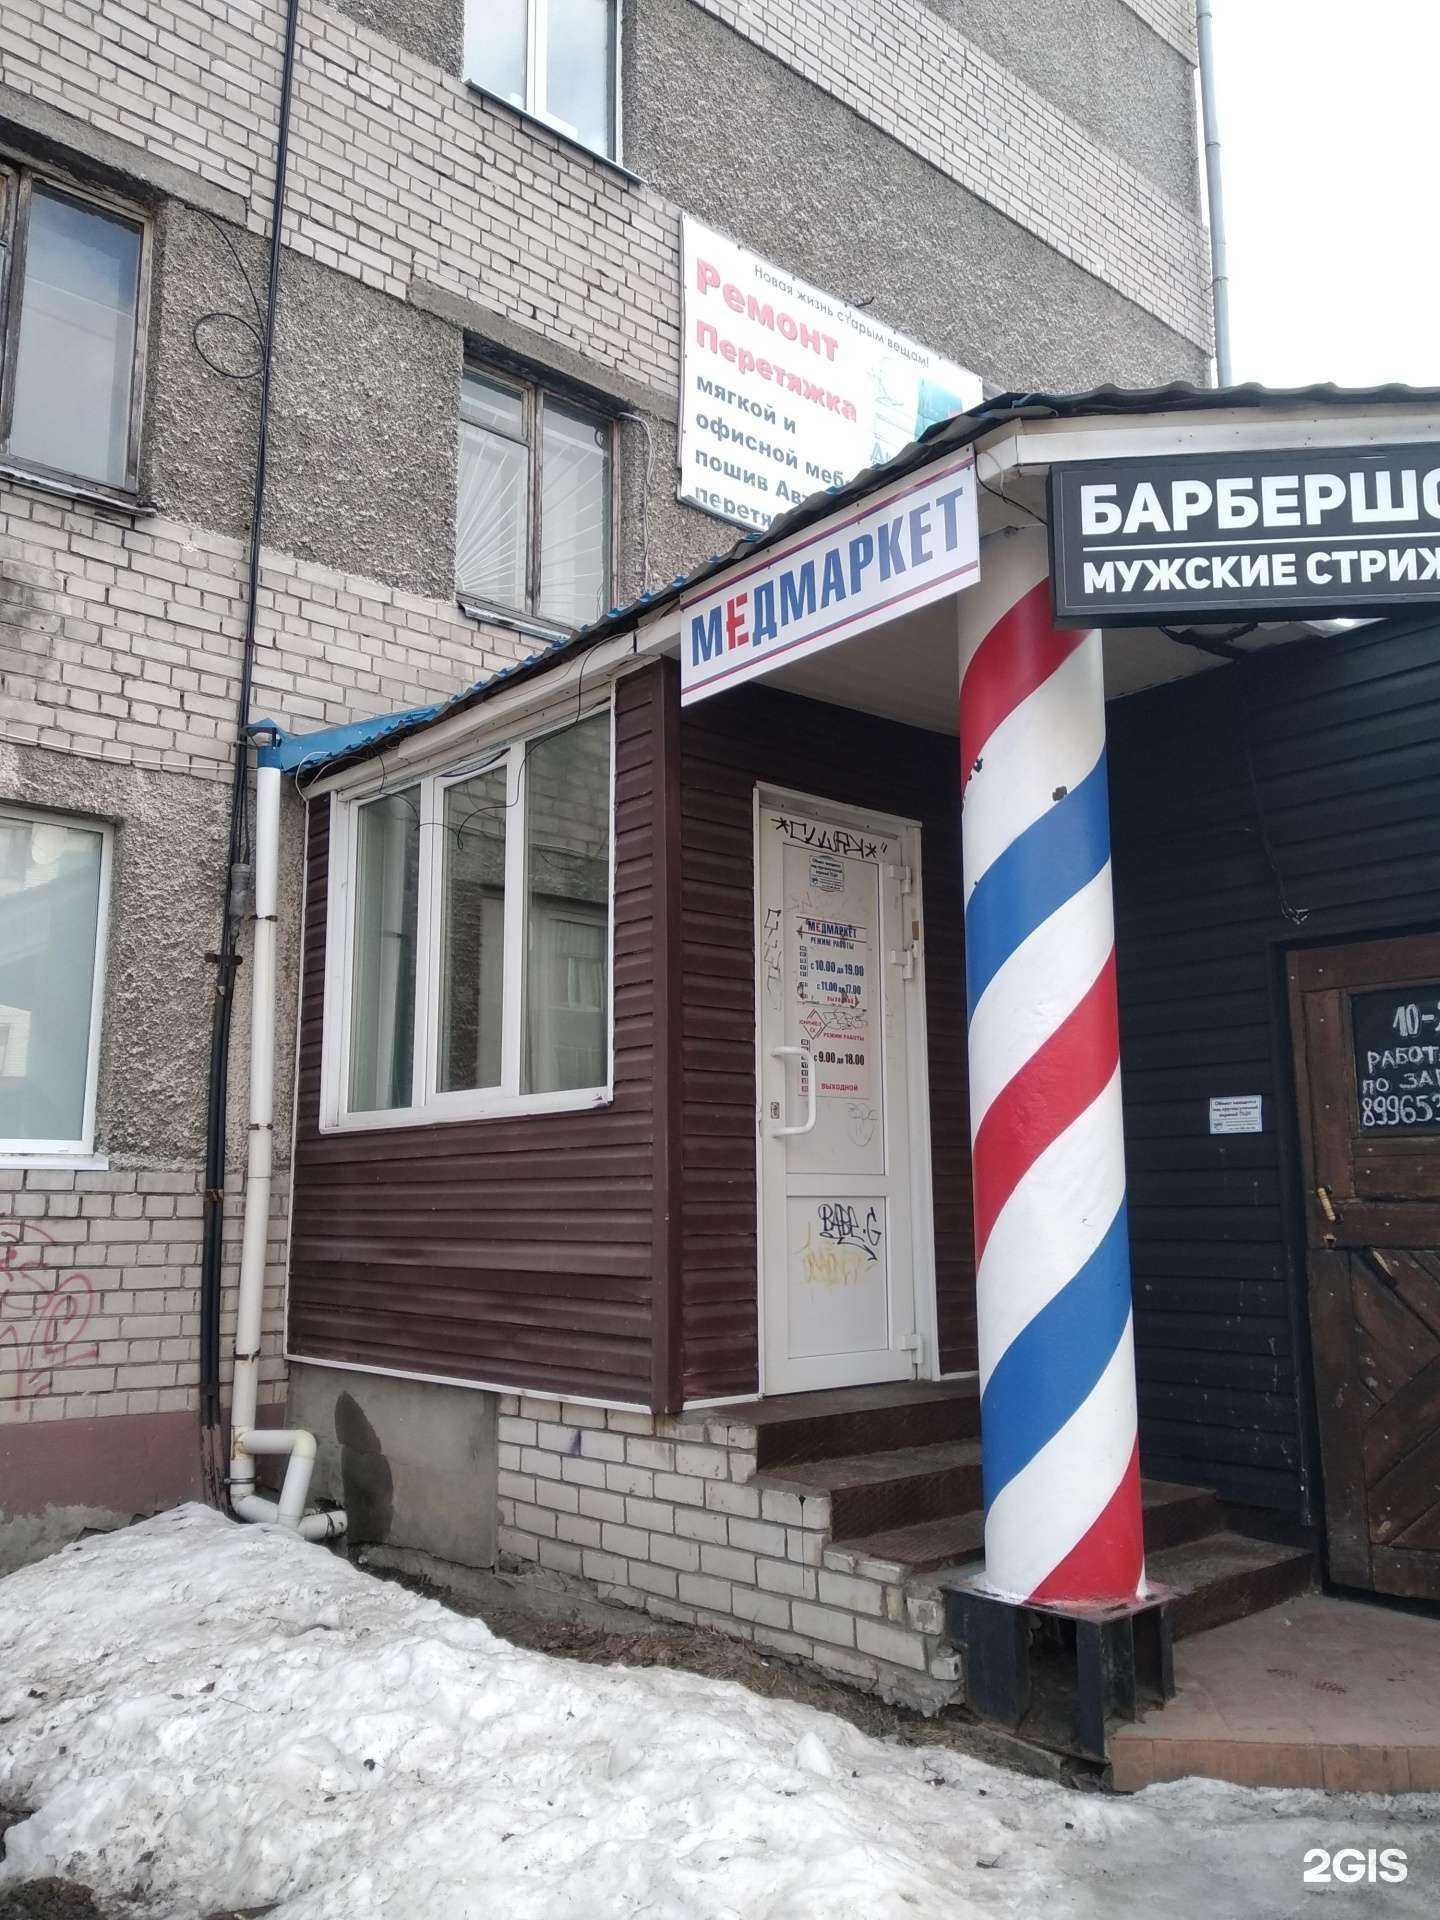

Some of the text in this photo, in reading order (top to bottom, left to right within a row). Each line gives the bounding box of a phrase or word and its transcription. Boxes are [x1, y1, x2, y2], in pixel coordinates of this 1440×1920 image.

[696, 257, 839, 362] Ремонт
[754, 264, 793, 296] Новая
[797, 290, 834, 317] жизнь
[887, 338, 929, 368] вещам!
[696, 319, 857, 423] Перетяжка
[696, 375, 797, 434] мягкой и
[695, 449, 769, 491] пошив
[696, 413, 849, 487] офисной меб
[691, 487, 964, 667] МЕДМАРКЕТ
[1083, 553, 1298, 594] МУЖСКИЕ
[815, 960, 836, 973] 10.00
[845, 963, 864, 977] 19.00
[820, 981, 838, 992] 11.00
[845, 983, 862, 995] 17.00
[818, 1051, 836, 1063] 9.00
[845, 1053, 865, 1066] 18.00
[1367, 1045, 1440, 1074] РАБОТ
